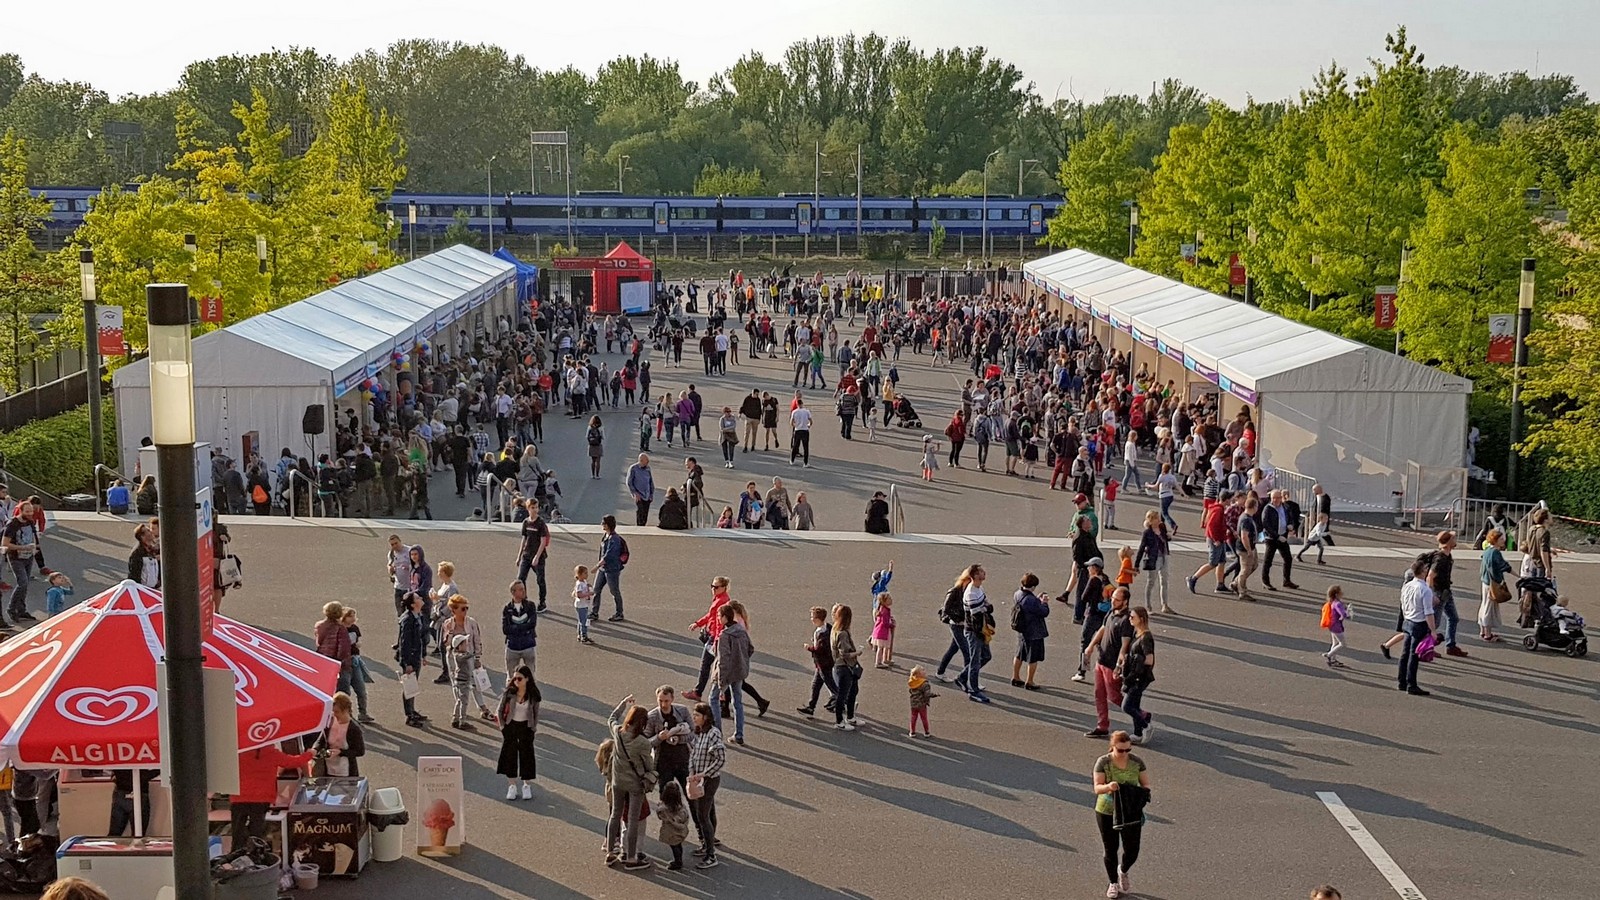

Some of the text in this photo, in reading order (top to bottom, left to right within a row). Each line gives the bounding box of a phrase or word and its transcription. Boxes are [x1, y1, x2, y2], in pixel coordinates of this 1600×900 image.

[613, 259, 627, 268] 10
[207, 297, 217, 319] TYSK
[1380, 295, 1390, 324] TYSKIE
[50, 742, 156, 762] ALGIDA
[293, 822, 353, 834] MAGNUM
